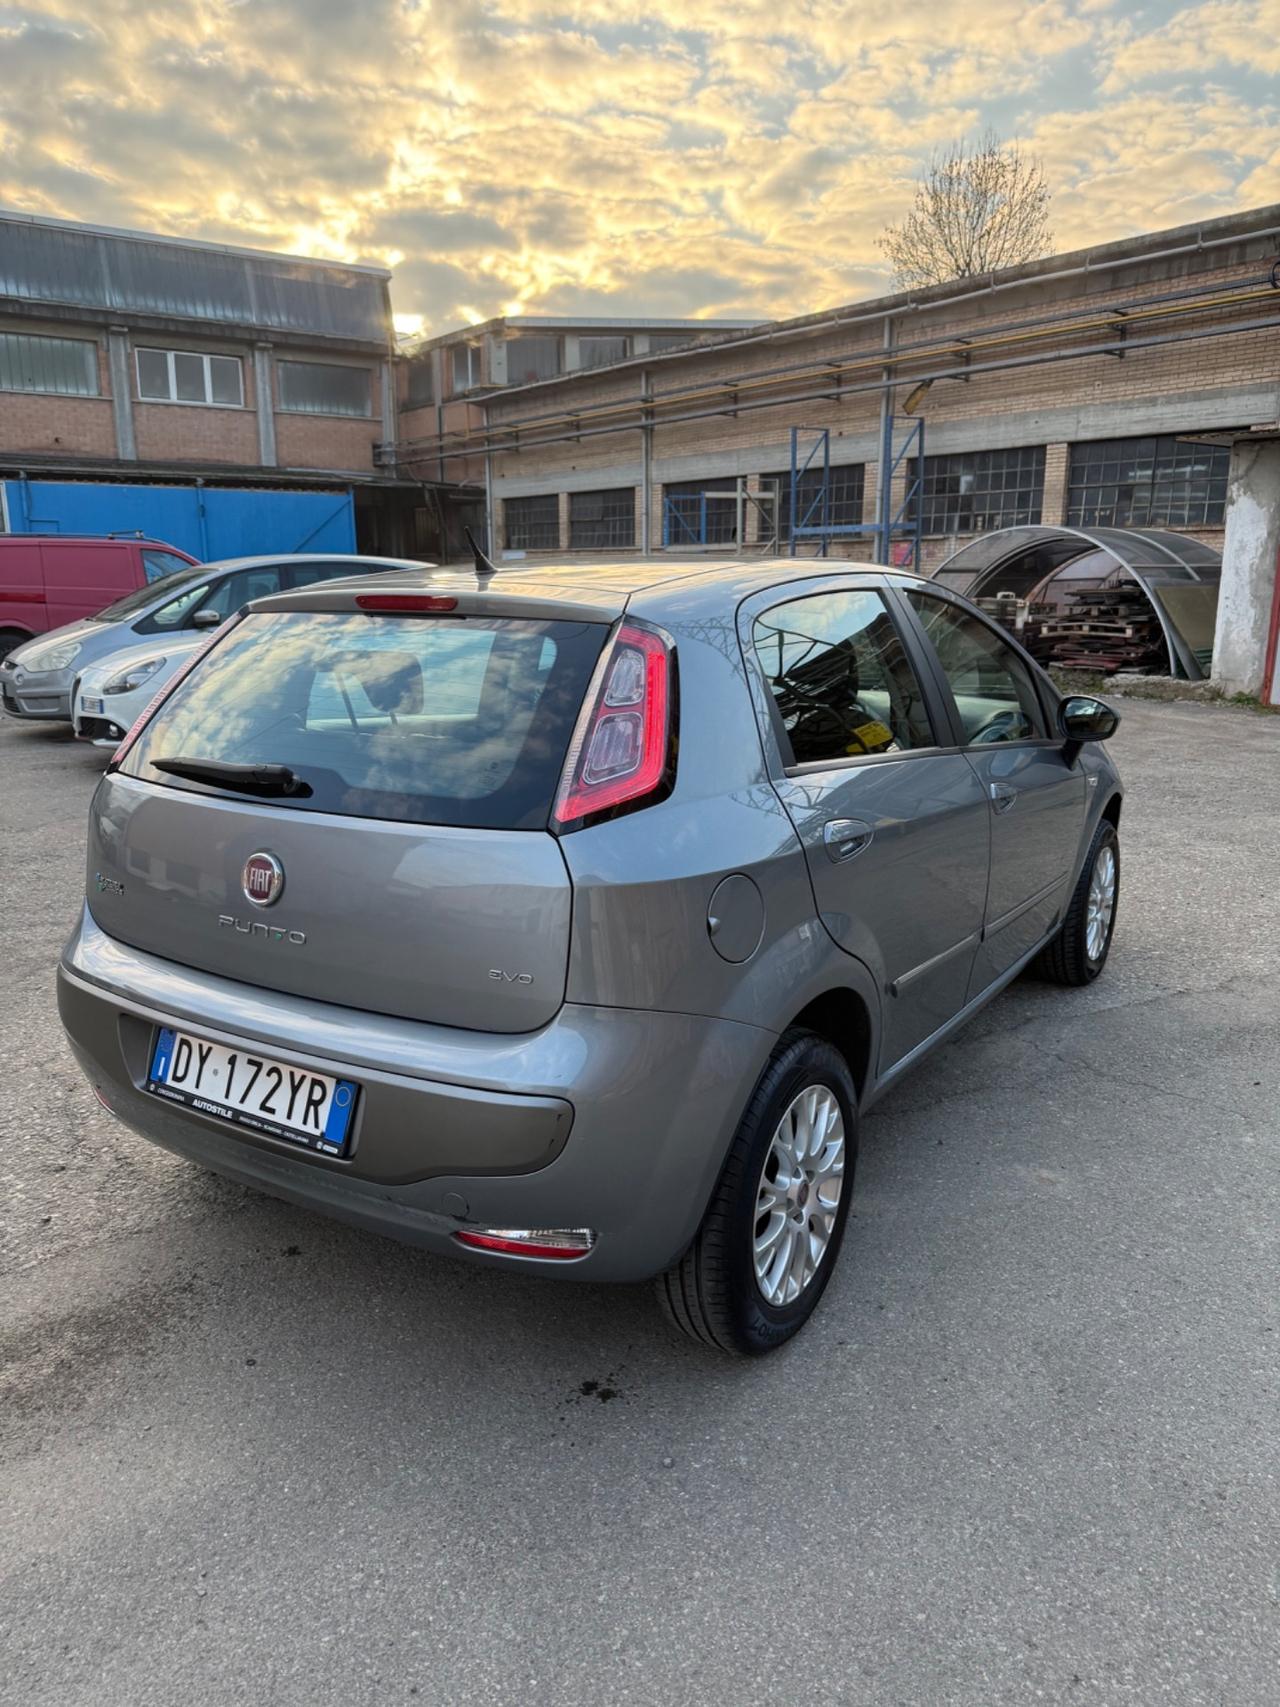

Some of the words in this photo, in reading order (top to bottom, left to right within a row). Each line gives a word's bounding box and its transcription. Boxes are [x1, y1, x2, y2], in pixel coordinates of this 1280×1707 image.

[250, 867, 271, 892] FIAT
[219, 914, 306, 944] PUNTO
[488, 969, 533, 984] EVO
